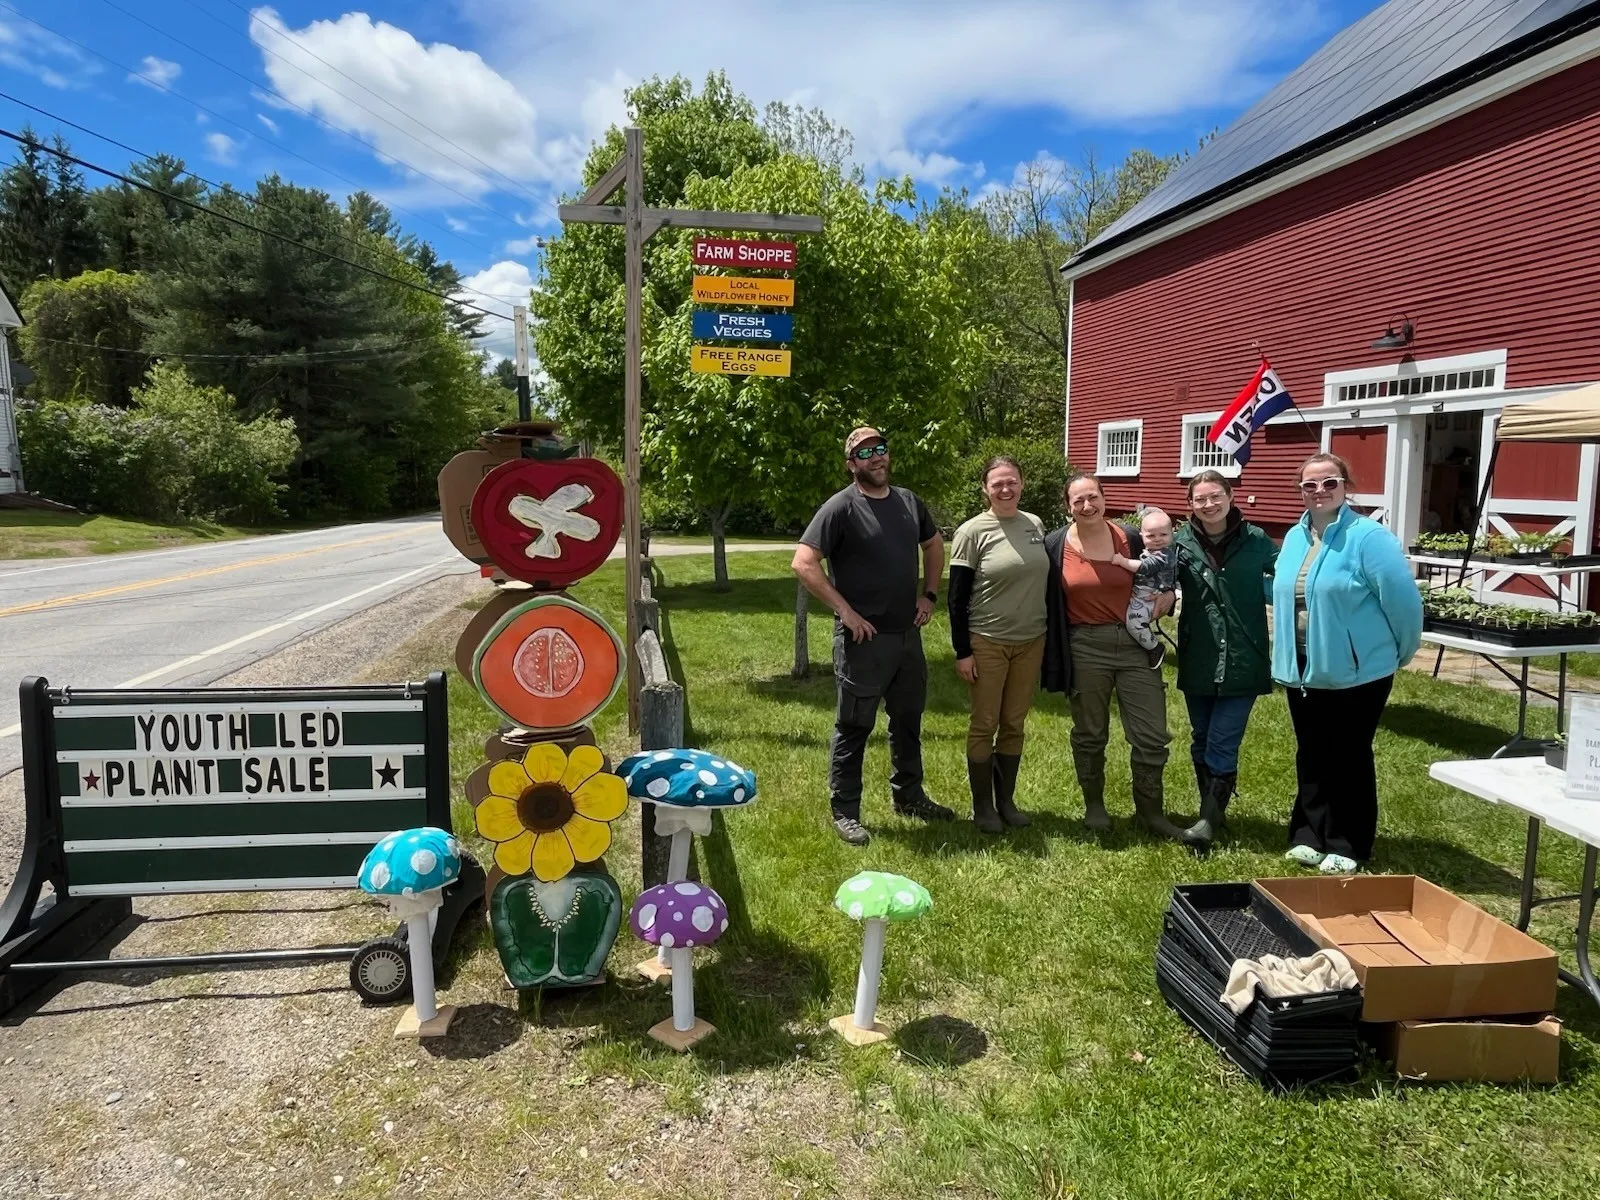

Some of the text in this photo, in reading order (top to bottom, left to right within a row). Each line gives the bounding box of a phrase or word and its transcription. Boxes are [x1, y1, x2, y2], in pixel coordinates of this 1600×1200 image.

[696, 243, 792, 263] FARM SHOPPE
[730, 280, 760, 290] LOCAL
[697, 290, 790, 302] WILDFLOWER HONEY
[719, 314, 765, 326] FRESH
[713, 326, 772, 338] VEGGIES
[700, 350, 782, 362] FREE RANGE
[721, 361, 756, 372] EGGS
[137, 712, 340, 751] YOUTH LED
[1589, 755, 1600, 768] PL
[105, 757, 325, 797] PLANT SALE
